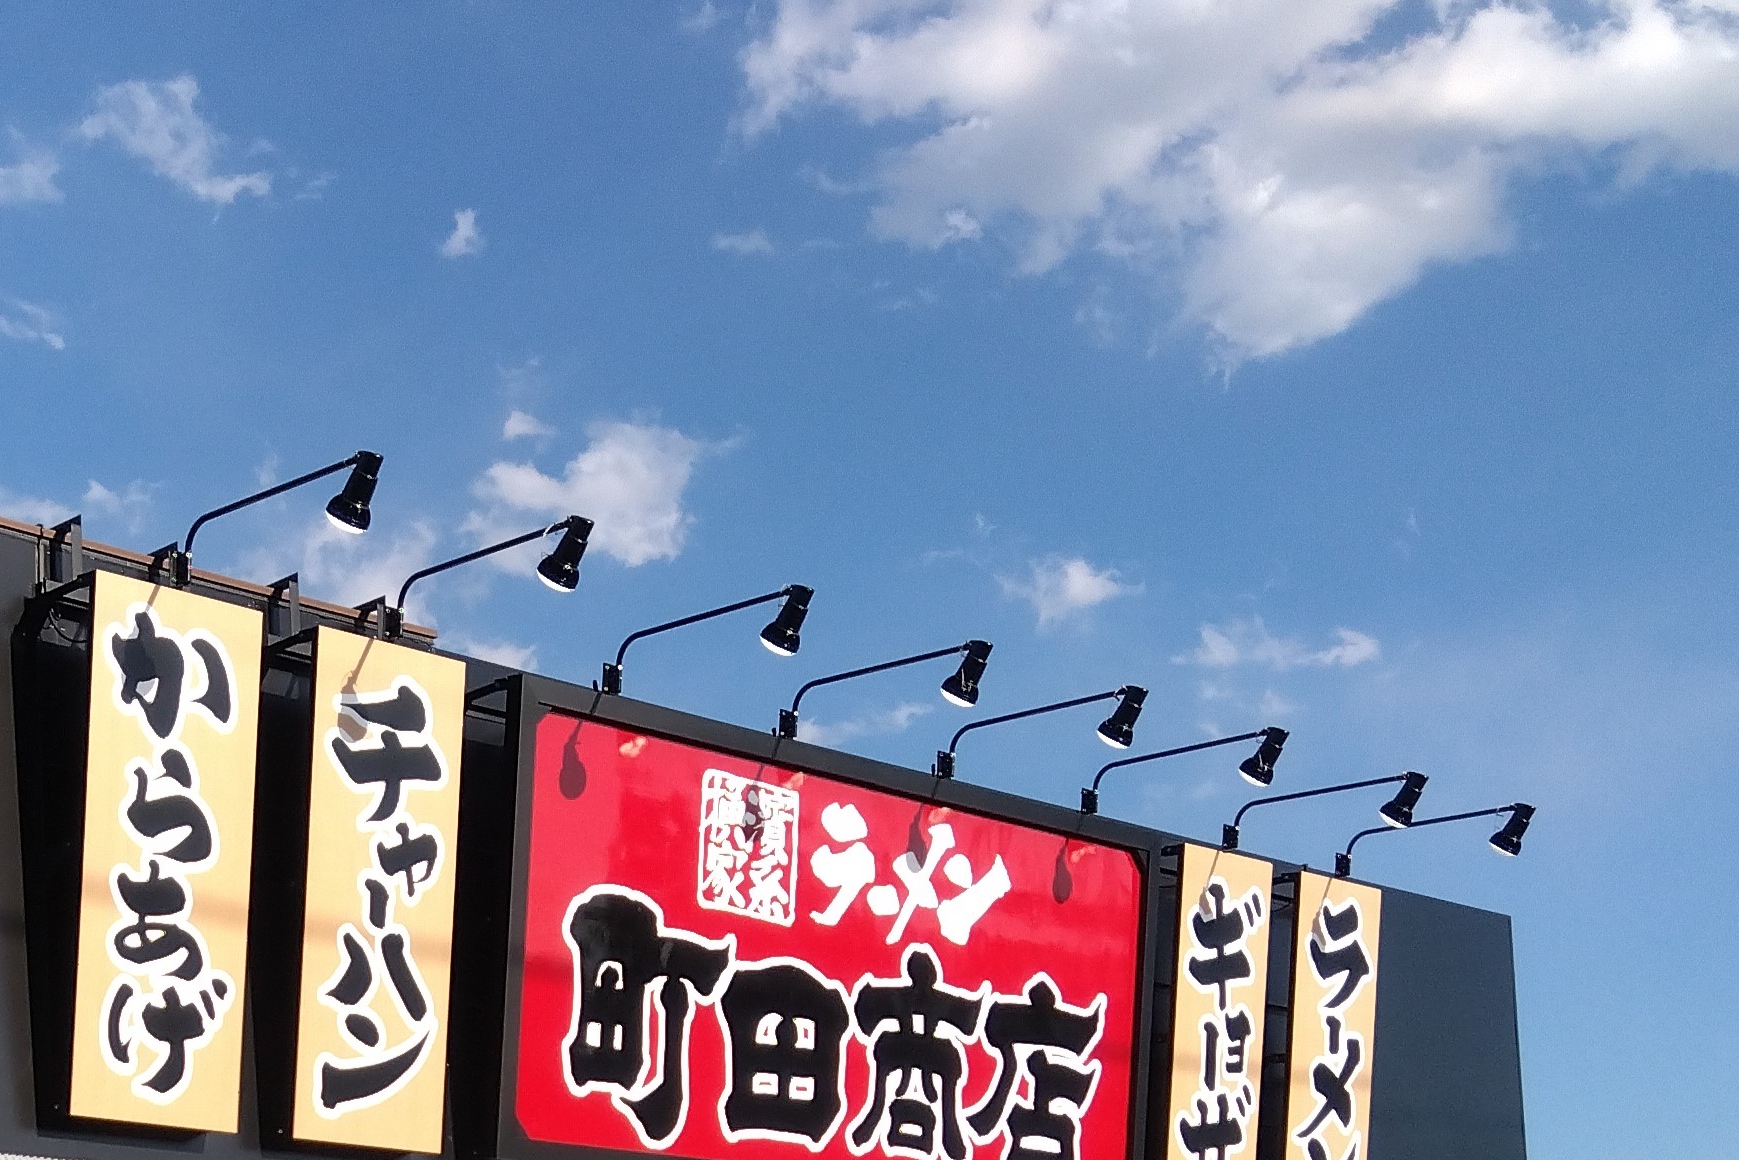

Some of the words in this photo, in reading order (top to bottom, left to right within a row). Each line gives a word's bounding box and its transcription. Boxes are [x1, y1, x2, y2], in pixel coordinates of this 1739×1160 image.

[107, 610, 232, 1094] からあげ
[318, 684, 444, 1110] チャーハン
[809, 801, 1012, 946] ラーメン
